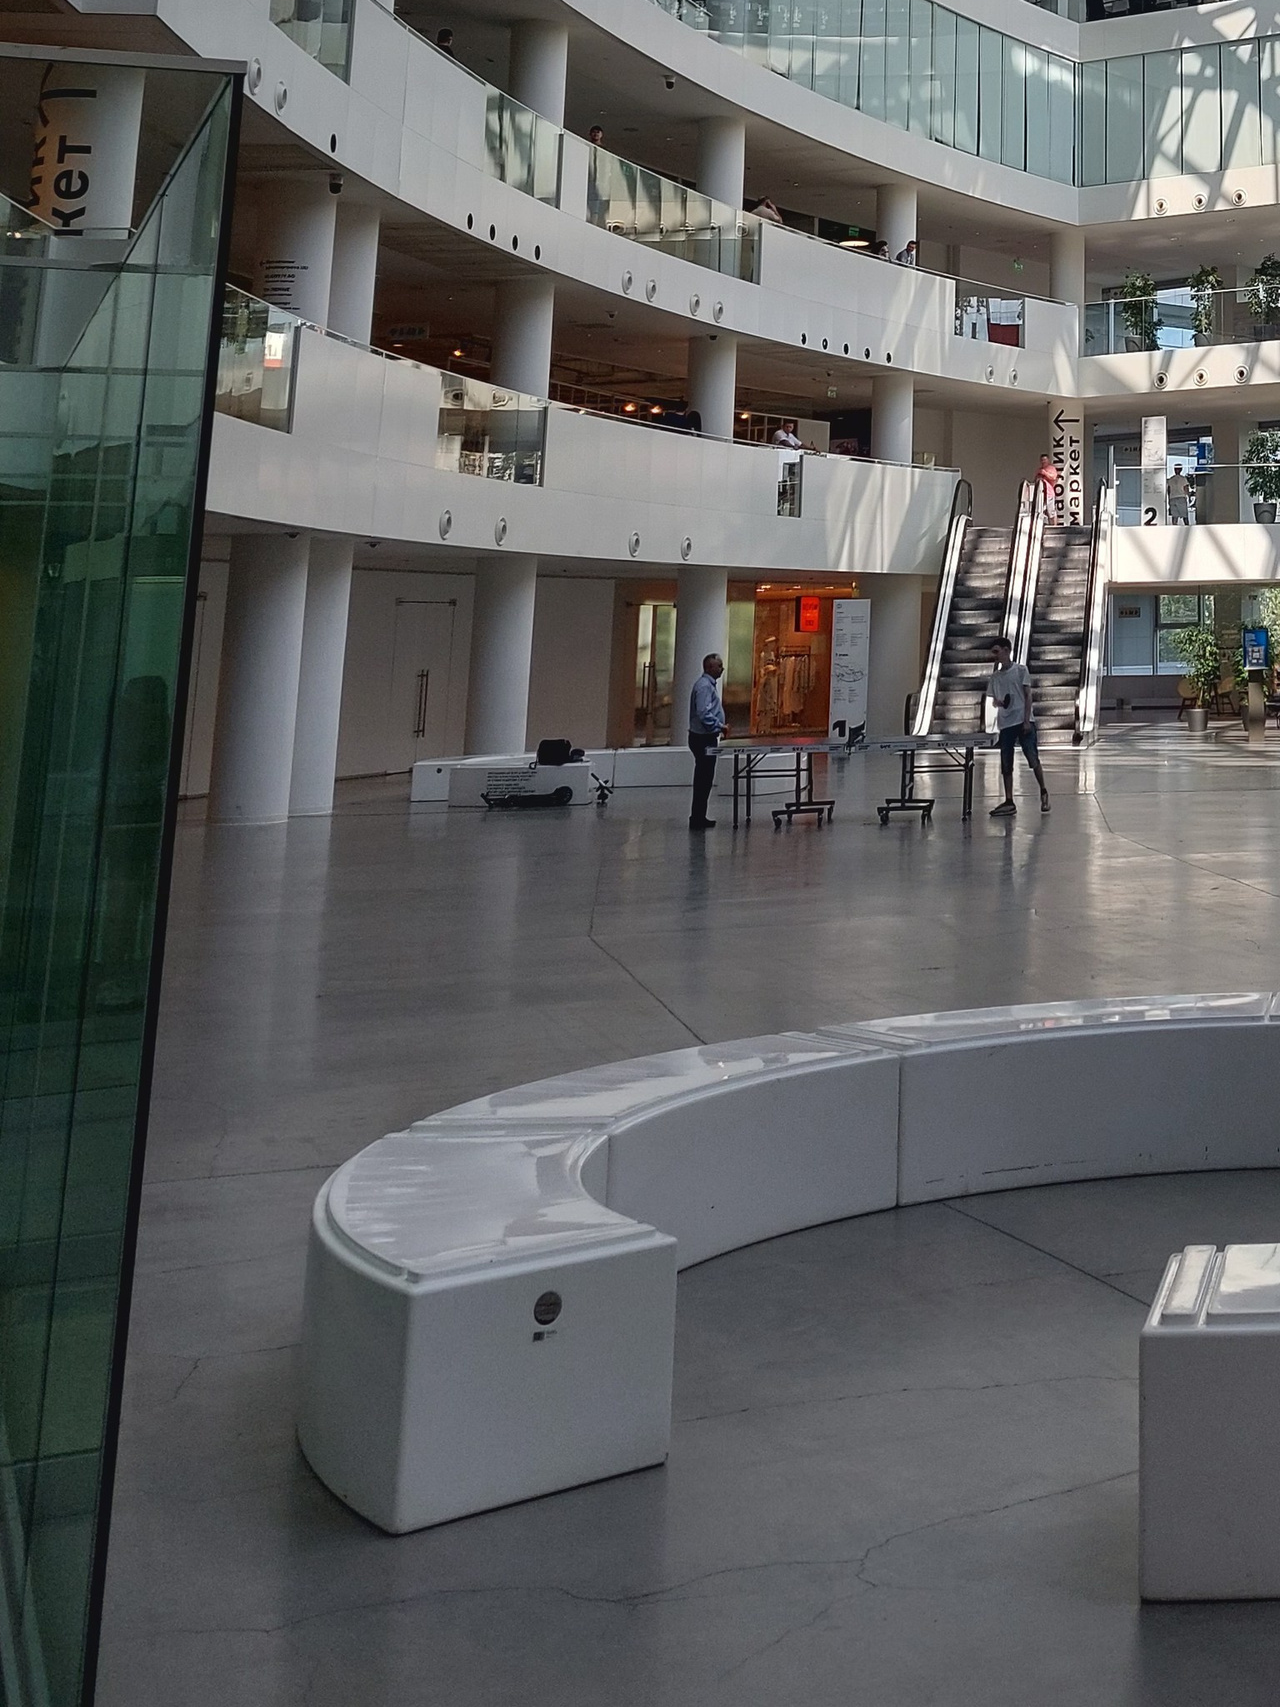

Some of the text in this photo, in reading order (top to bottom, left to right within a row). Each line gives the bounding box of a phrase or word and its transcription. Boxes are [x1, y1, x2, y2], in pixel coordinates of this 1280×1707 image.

[1069, 436, 1081, 526] маркет
[1144, 507, 1157, 526] 2
[832, 720, 847, 737] 1
